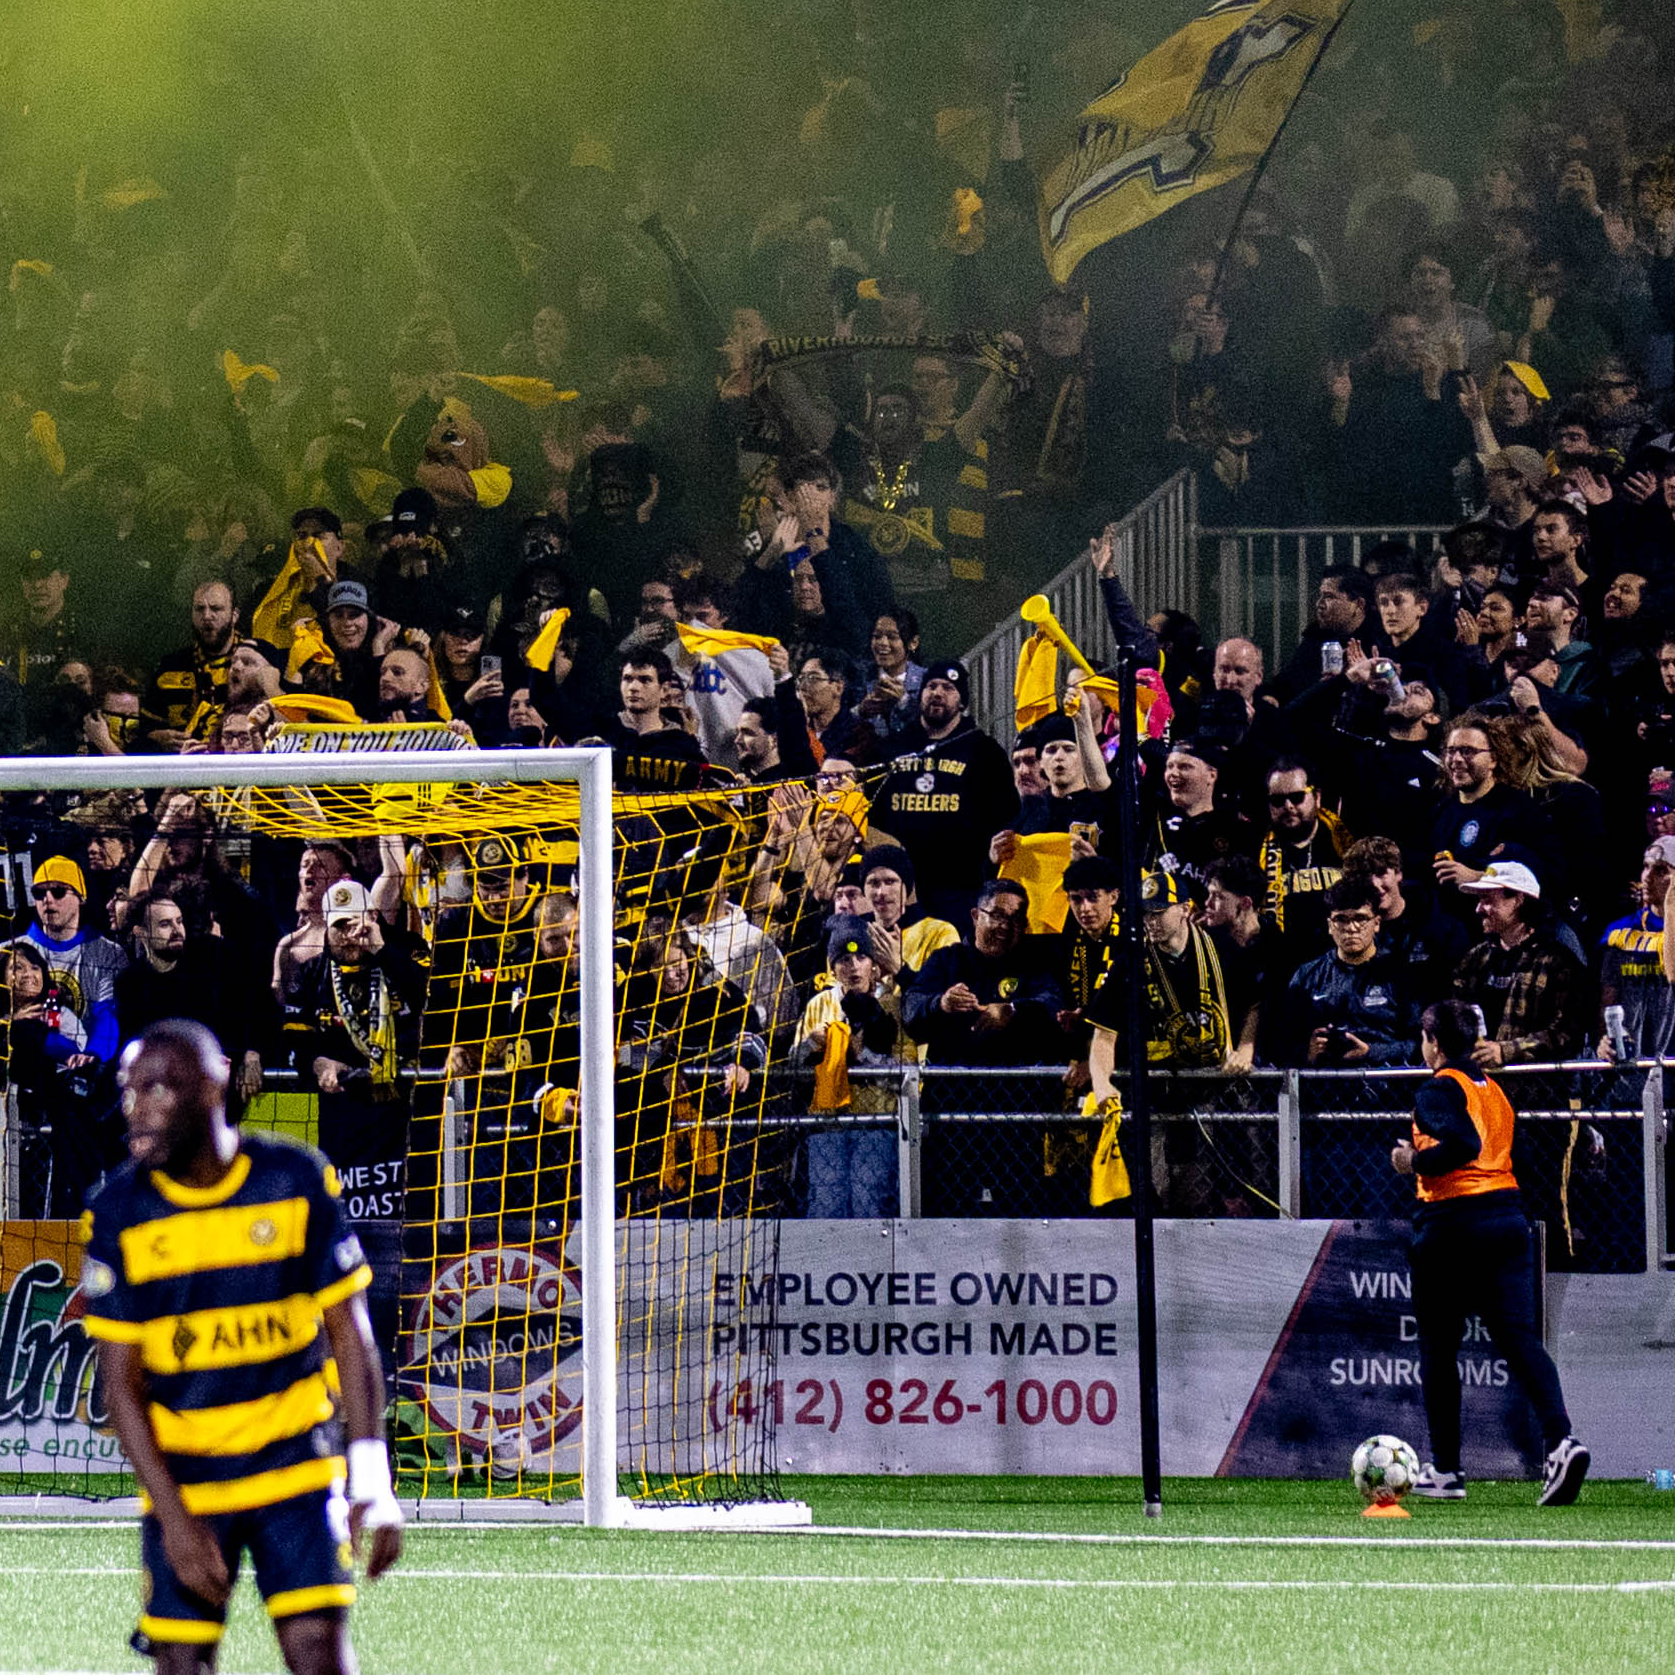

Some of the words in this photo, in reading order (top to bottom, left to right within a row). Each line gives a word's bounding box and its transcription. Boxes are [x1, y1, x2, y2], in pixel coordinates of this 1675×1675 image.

[310, 732, 344, 753] ON
[626, 755, 687, 786] ARMY
[891, 793, 961, 812] STEELERS
[338, 1160, 403, 1191] WEST
[344, 1190, 407, 1220] OAST
[714, 1272, 937, 1307] EMPLOYEE
[950, 1272, 1119, 1307] OWNED
[1349, 1272, 1412, 1300] WIN
[207, 1314, 294, 1352] AHN
[713, 1322, 972, 1357] PITTSBURGH
[990, 1322, 1118, 1357] MADE
[1400, 1316, 1492, 1343] DR
[433, 1319, 576, 1378] WINDOWS
[1331, 1359, 1509, 1387] SUNRMS
[469, 1385, 575, 1434] TWIN
[709, 1378, 845, 1433] (412)
[865, 1378, 1119, 1426] 826-1000
